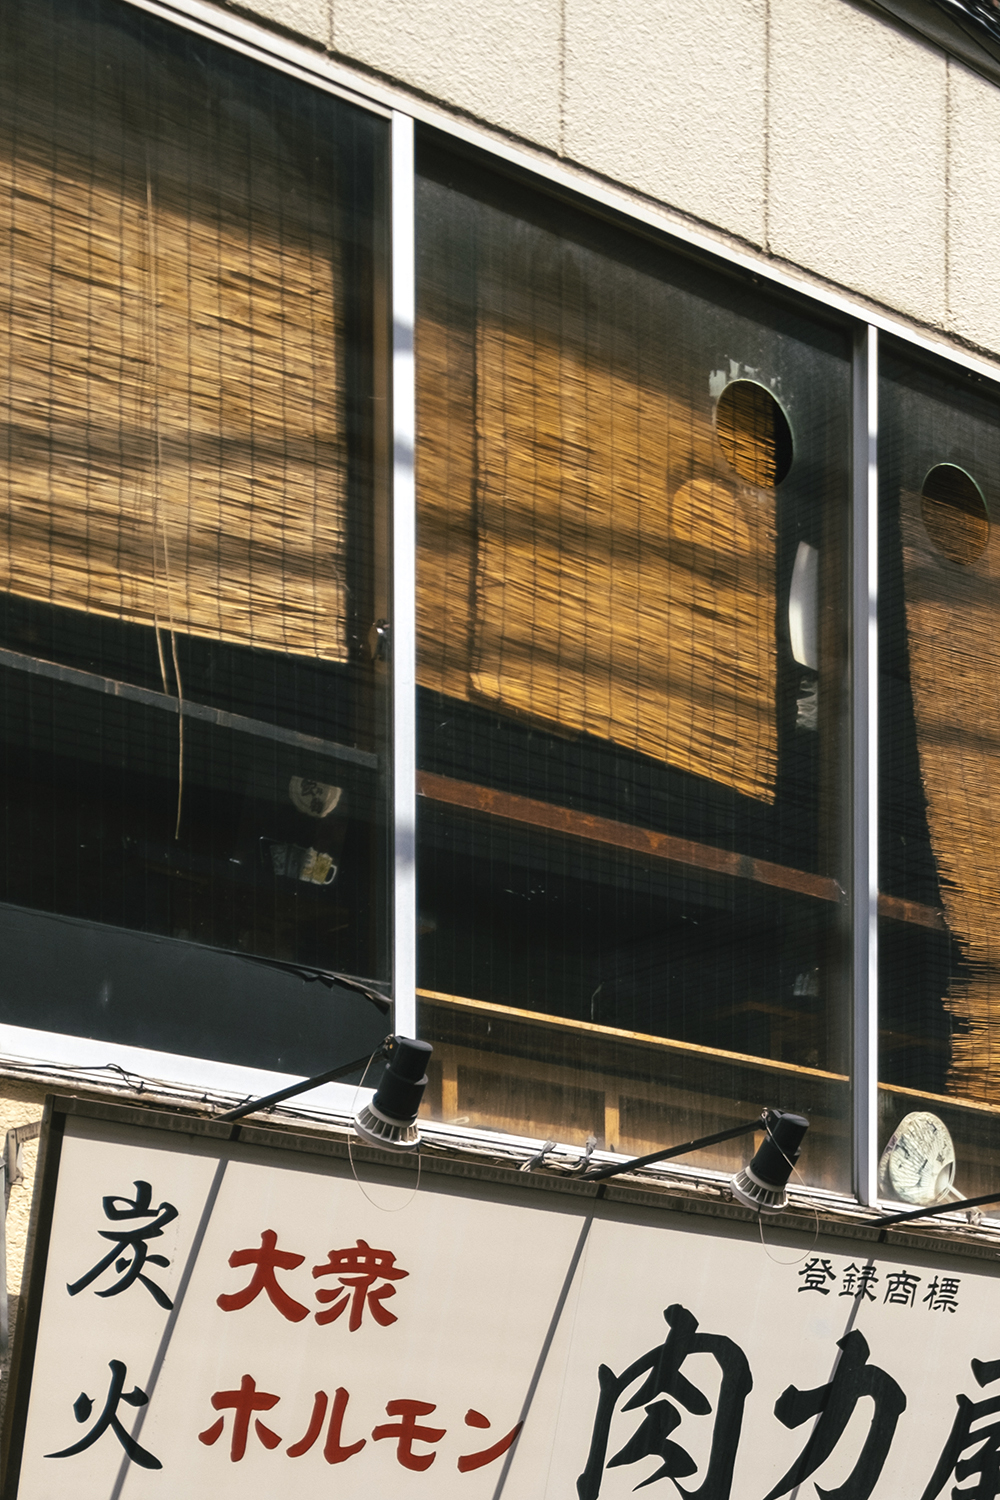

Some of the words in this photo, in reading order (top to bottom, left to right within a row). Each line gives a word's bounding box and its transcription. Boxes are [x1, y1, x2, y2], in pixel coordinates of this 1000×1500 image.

[44, 1179, 179, 1471] 炭火
[217, 1228, 409, 1333] 大衆
[797, 1257, 960, 1314] 登録商標
[198, 1374, 523, 1473] ホルモン
